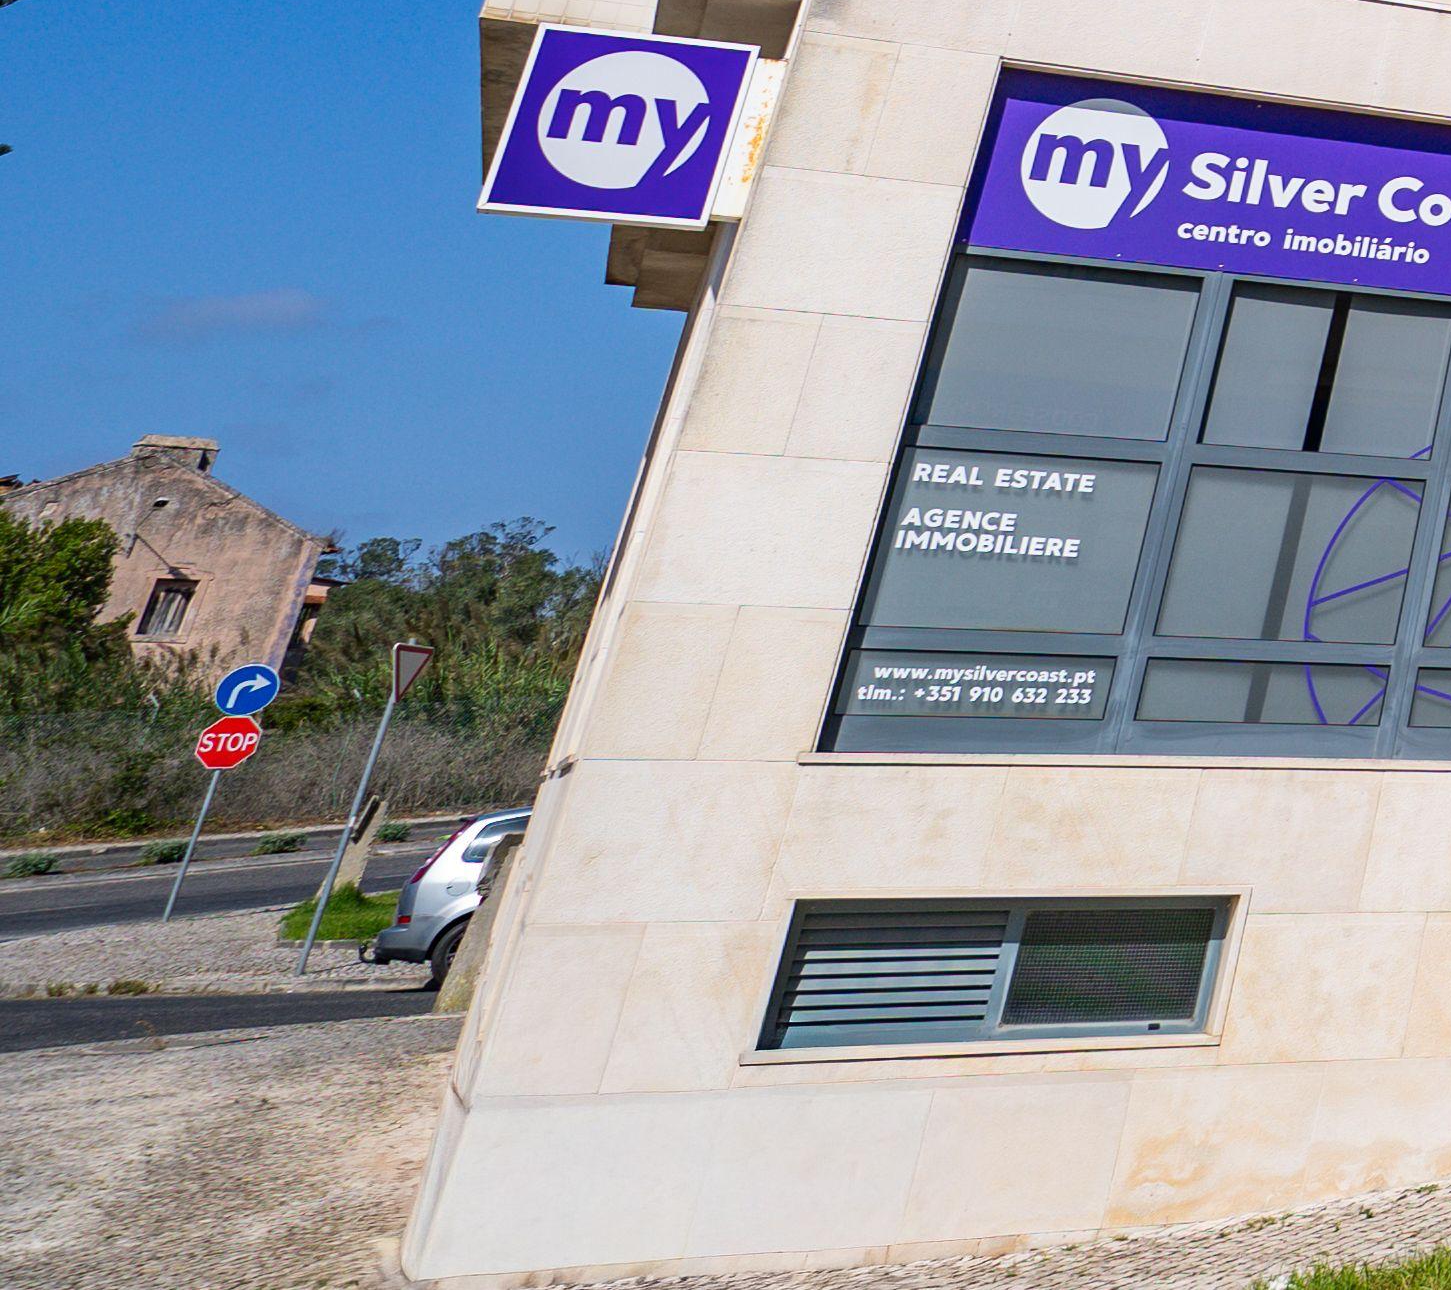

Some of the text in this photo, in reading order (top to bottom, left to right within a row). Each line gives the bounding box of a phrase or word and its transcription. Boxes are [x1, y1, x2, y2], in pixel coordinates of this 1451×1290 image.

[546, 88, 710, 188] my
[1029, 131, 1170, 228] my
[1182, 151, 1367, 217] Silver
[1177, 219, 1430, 265] centro imobiliário
[912, 463, 1096, 493] REAL ESTATE
[901, 507, 1018, 532] AGENCE
[894, 530, 1081, 558] IMMOBILIERE
[873, 665, 1096, 687] www.mysilvercoast.pt
[857, 684, 1092, 704] tlm.: +351 910 632 233
[199, 732, 258, 753] STOP
